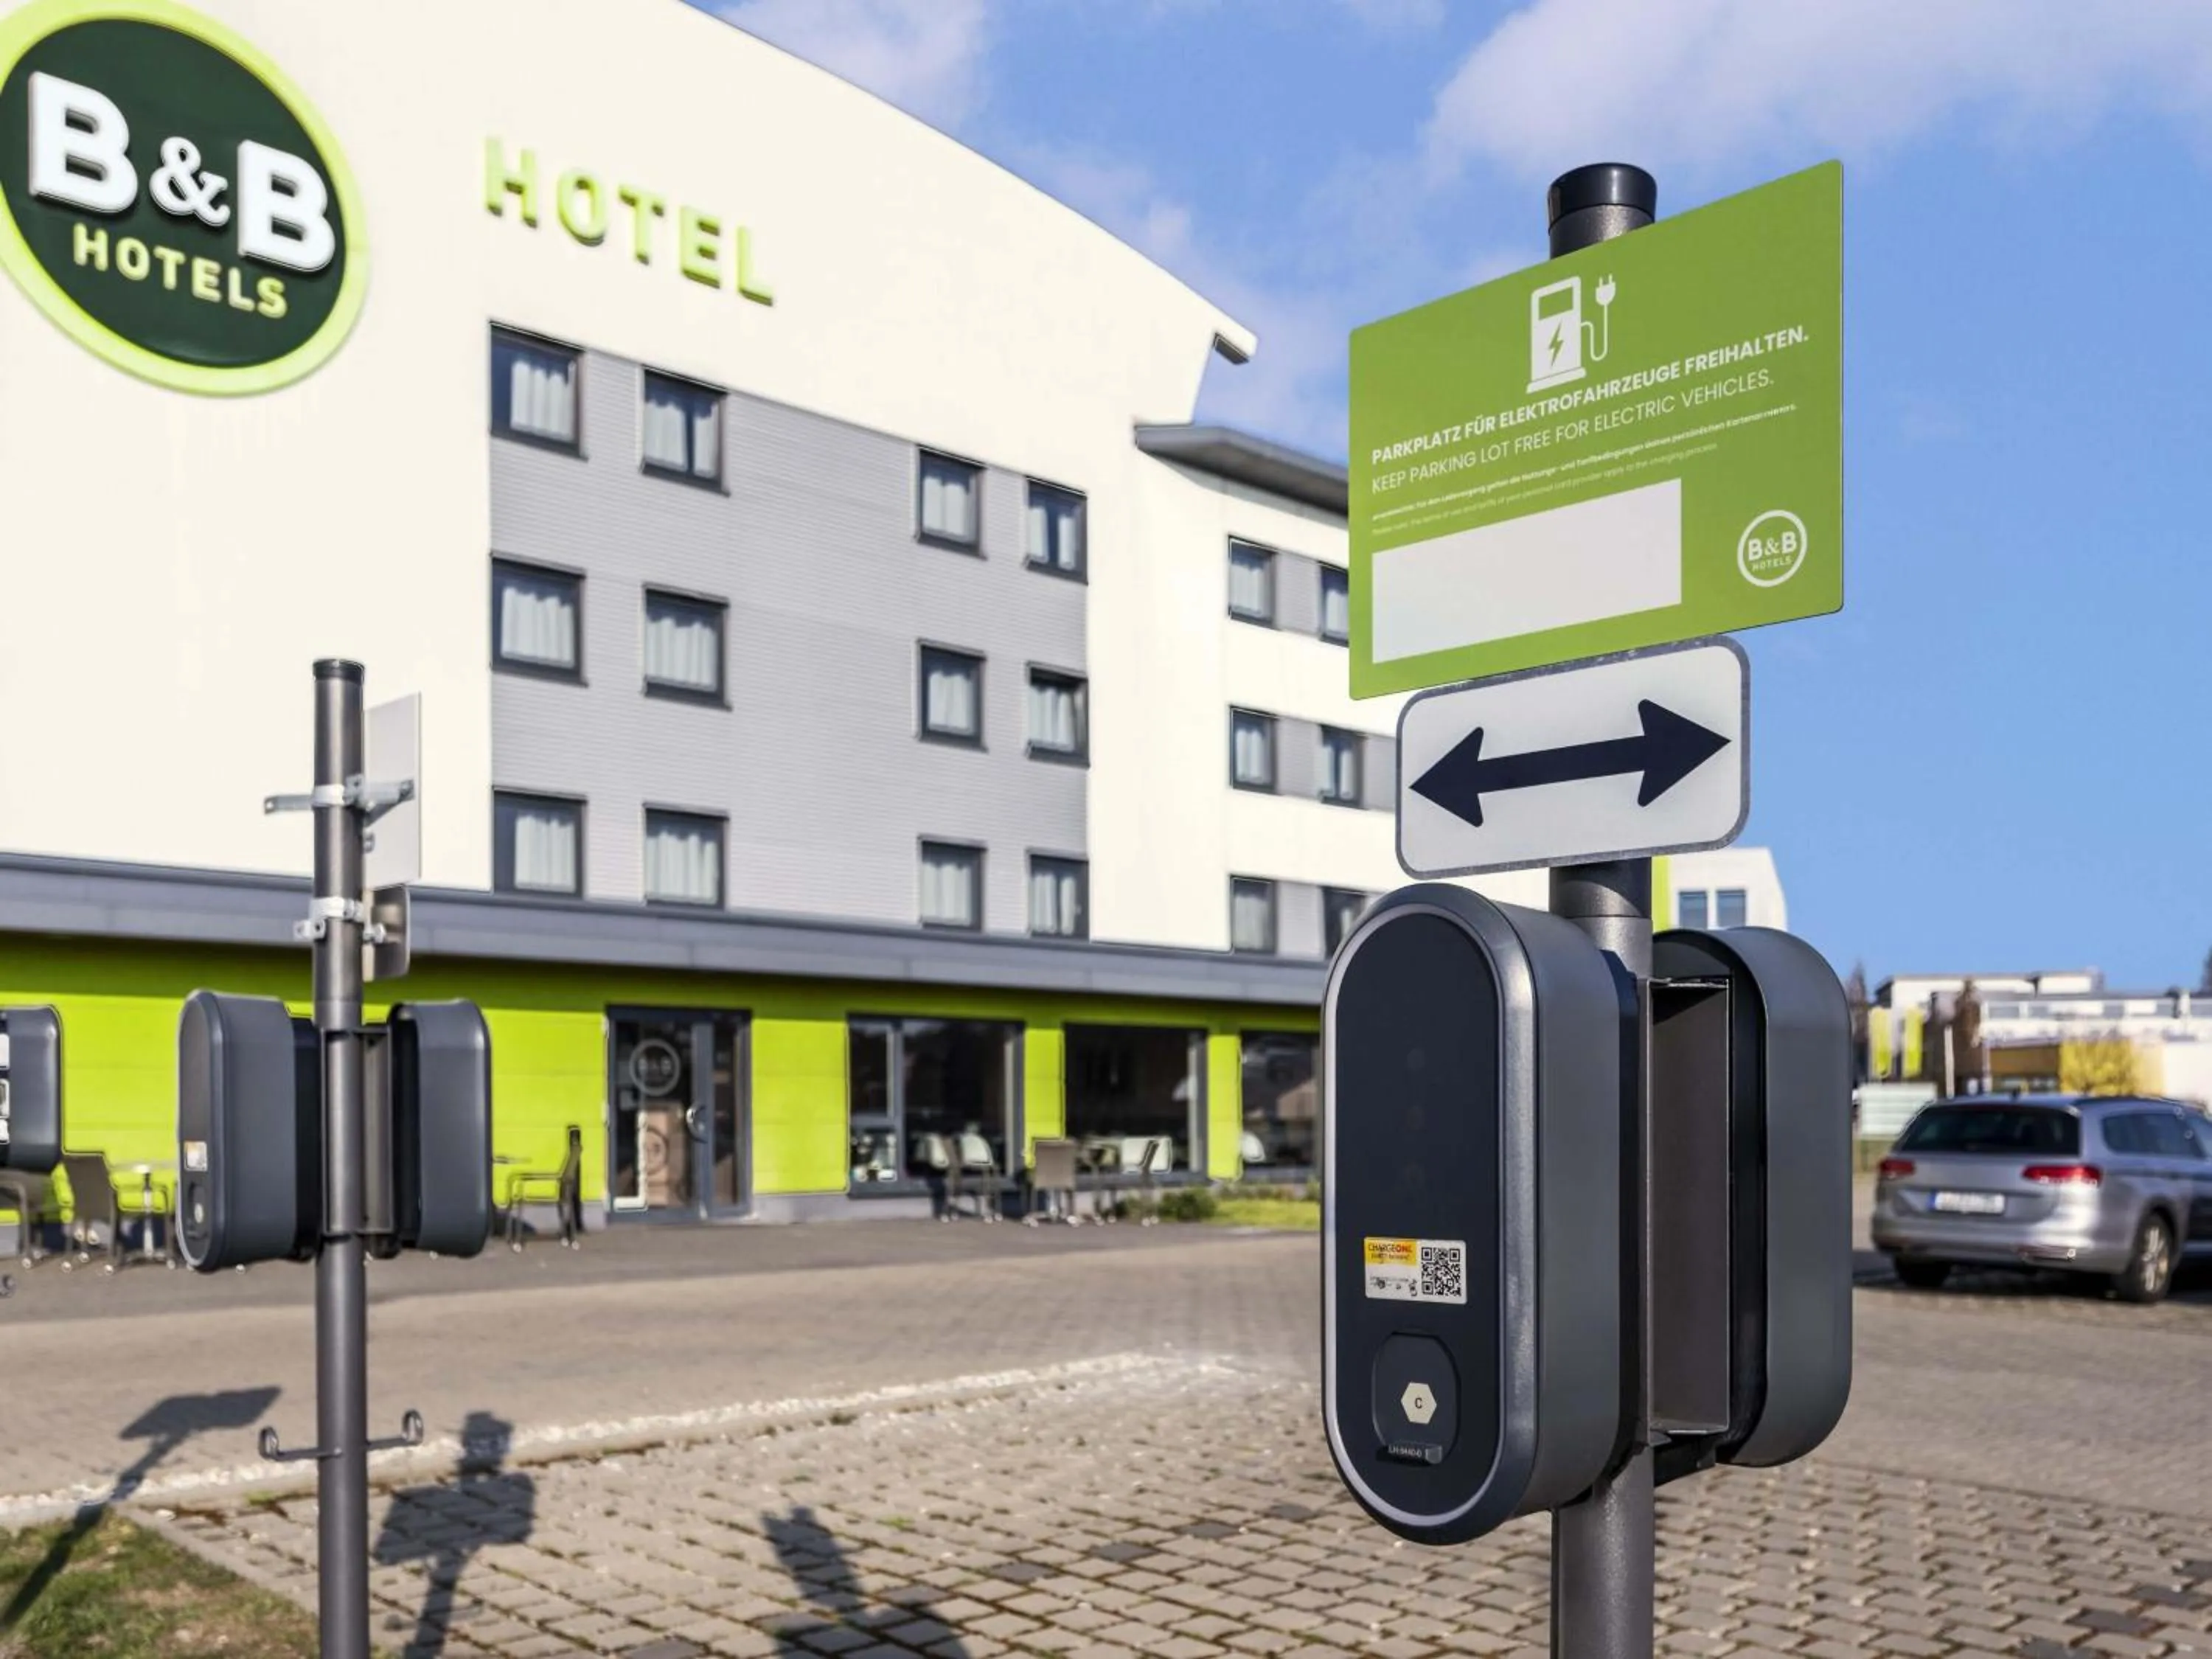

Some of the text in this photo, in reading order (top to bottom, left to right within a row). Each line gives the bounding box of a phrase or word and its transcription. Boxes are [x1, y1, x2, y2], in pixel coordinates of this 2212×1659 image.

[28, 71, 336, 273] B&B
[485, 136, 775, 307] HOTEL
[73, 222, 289, 319] HOTELS
[1371, 368, 1775, 495] KEEP PARKING LOT FREE FOR ELECTRIC VEHICLES.
[1372, 425, 1462, 465] PARKPLATZ
[1464, 414, 1496, 439] FÜR
[1499, 361, 1681, 428] ELEKTROFAHRZEUGE
[1684, 324, 1809, 376] FREIHALTEN.
[1748, 531, 1798, 561] B&B
[1752, 554, 1792, 572] HOTELS
[1414, 1397, 1423, 1410] C
